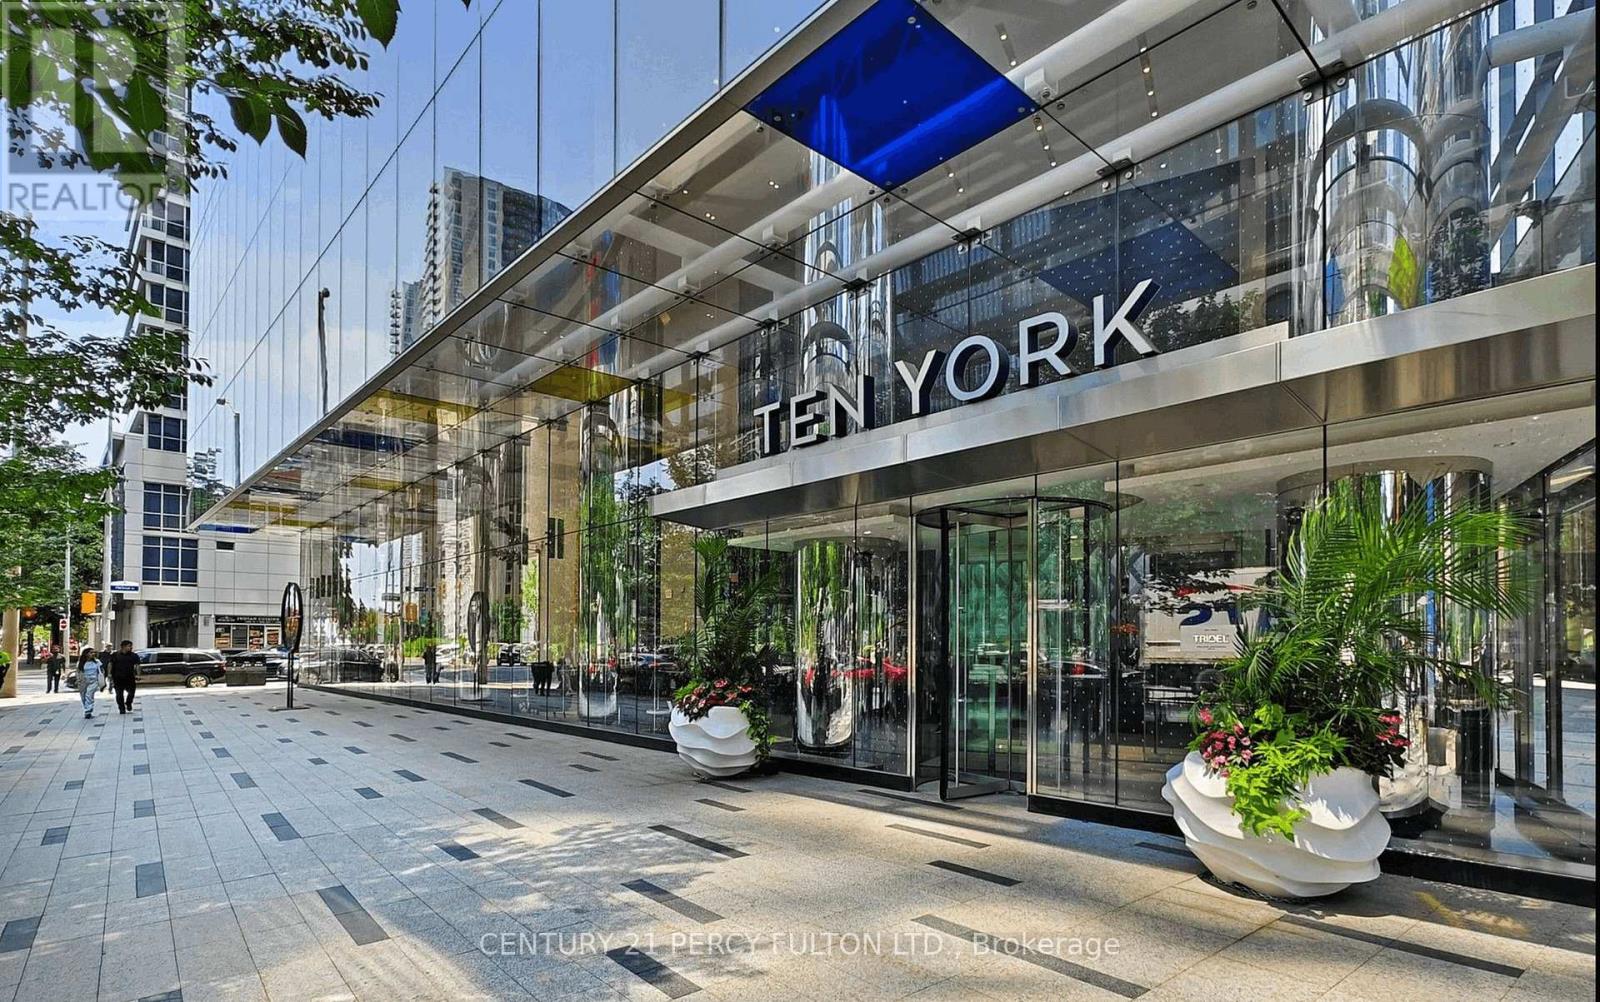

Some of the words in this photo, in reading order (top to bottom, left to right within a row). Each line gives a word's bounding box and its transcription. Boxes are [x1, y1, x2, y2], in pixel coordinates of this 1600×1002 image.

[753, 374, 875, 456] TEN
[894, 277, 1162, 416] YORK
[1193, 633, 1229, 643] TRIDEL
